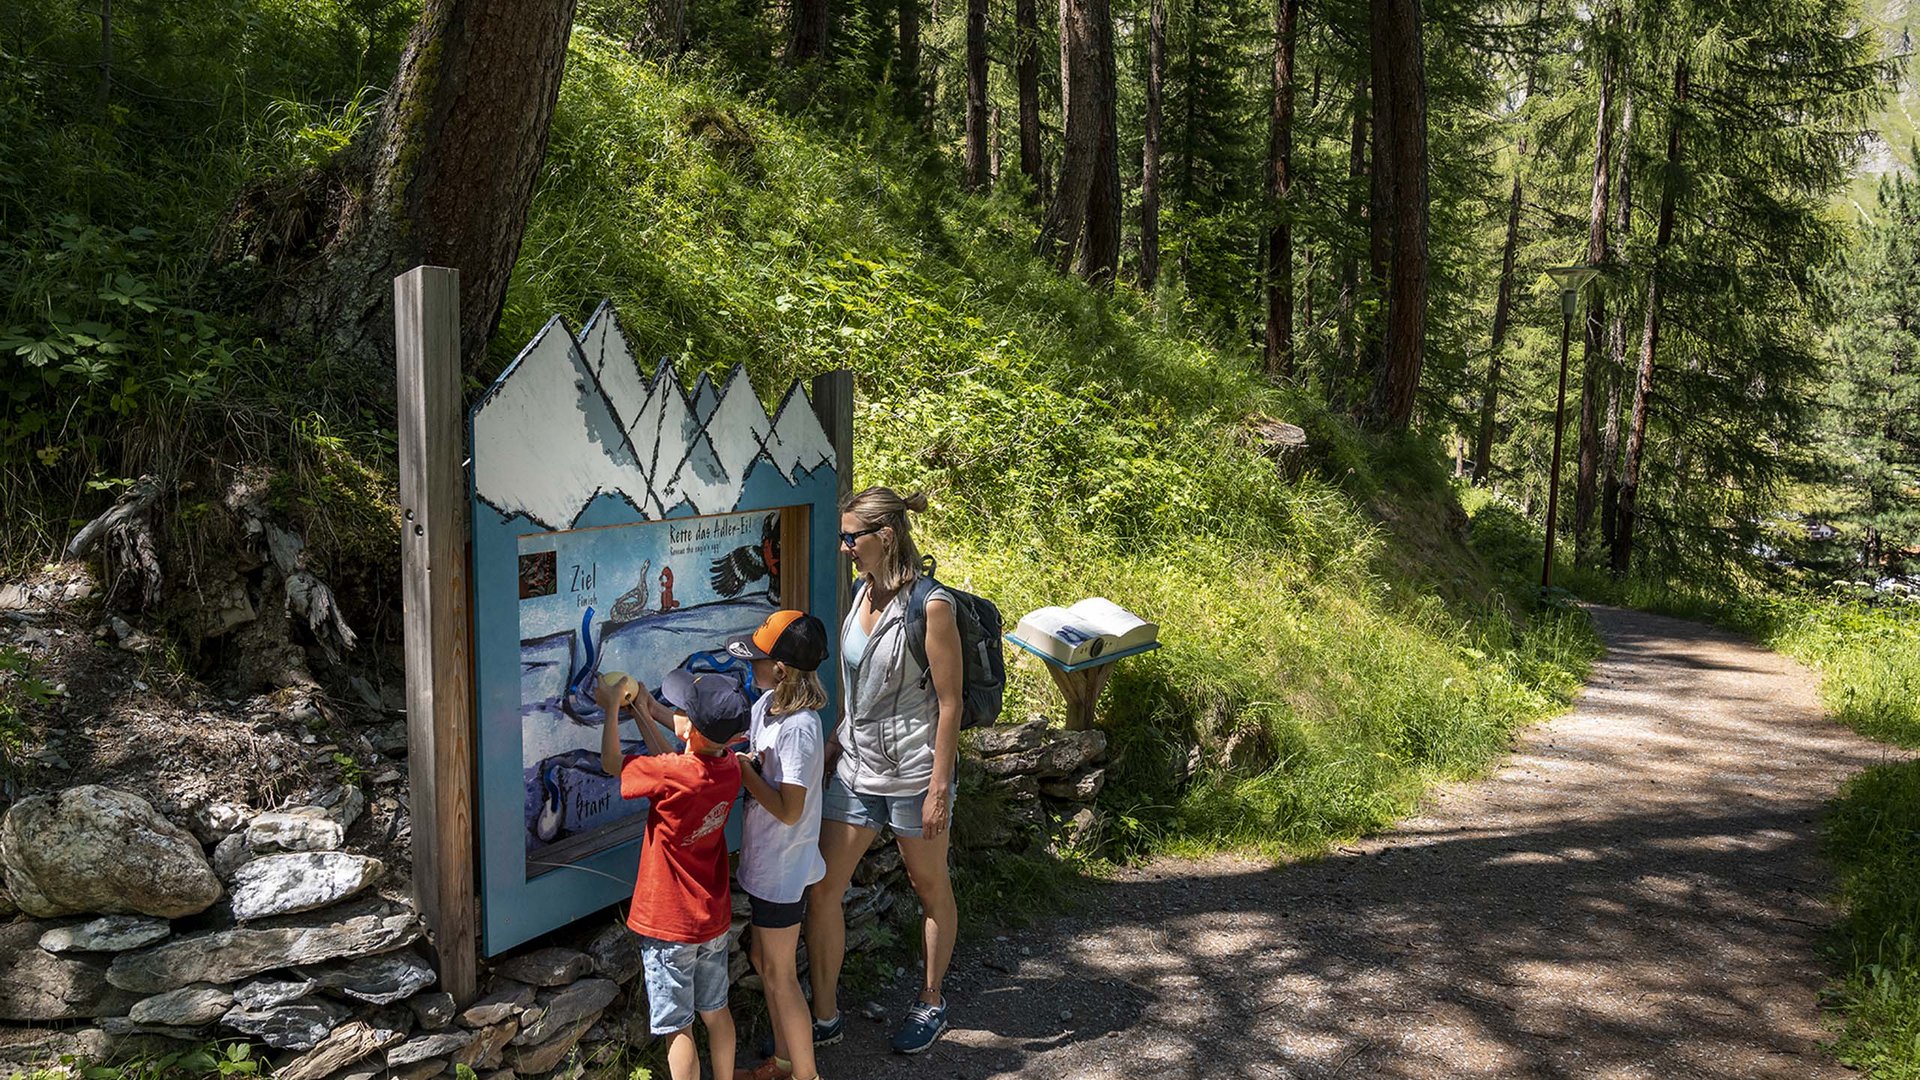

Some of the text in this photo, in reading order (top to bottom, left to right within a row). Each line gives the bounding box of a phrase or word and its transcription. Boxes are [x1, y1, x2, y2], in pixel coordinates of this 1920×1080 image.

[670, 516, 752, 543] Rette das Adler-Ei!
[571, 562, 596, 592] Ziel
[577, 592, 597, 607] Finish
[576, 792, 611, 820] Start
